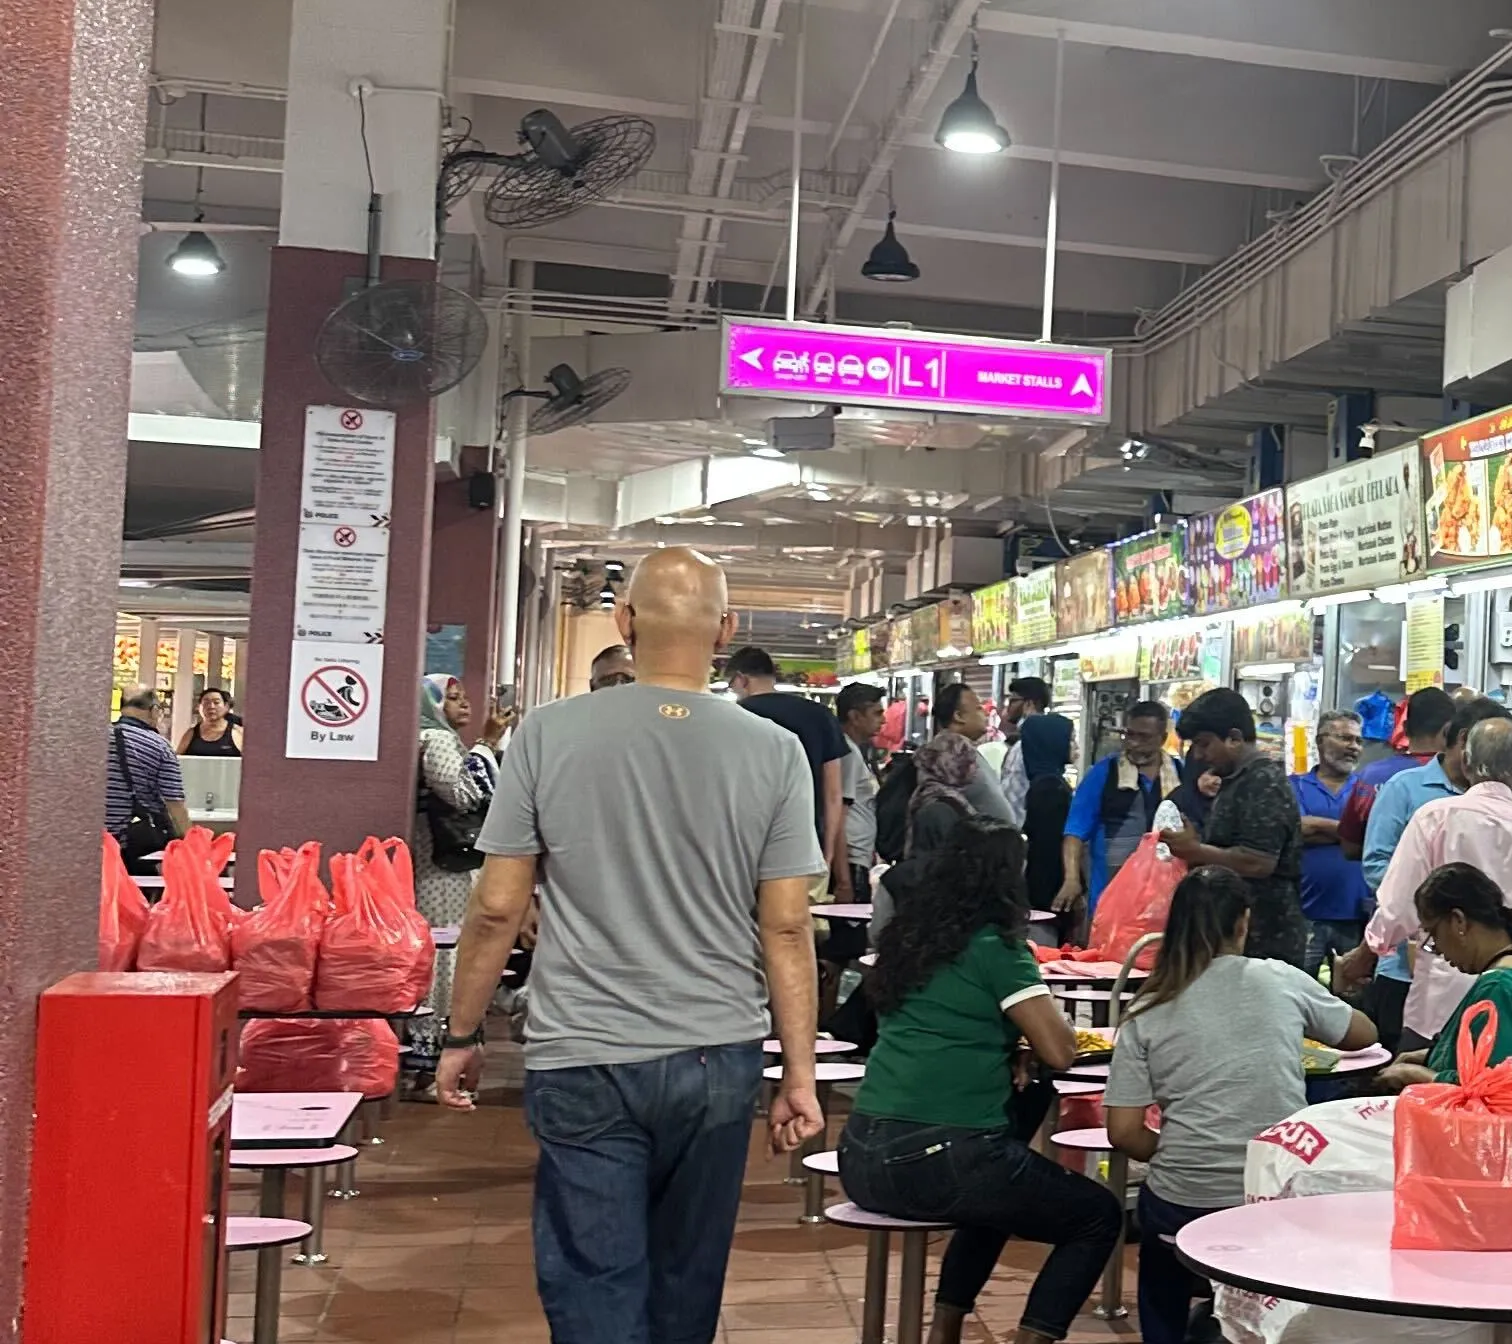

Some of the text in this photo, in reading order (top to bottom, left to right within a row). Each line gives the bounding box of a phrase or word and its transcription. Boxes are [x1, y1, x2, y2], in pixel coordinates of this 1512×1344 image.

[903, 356, 939, 388] L1
[978, 371, 1063, 389] MARKET STALLS
[311, 731, 355, 742] By Law
